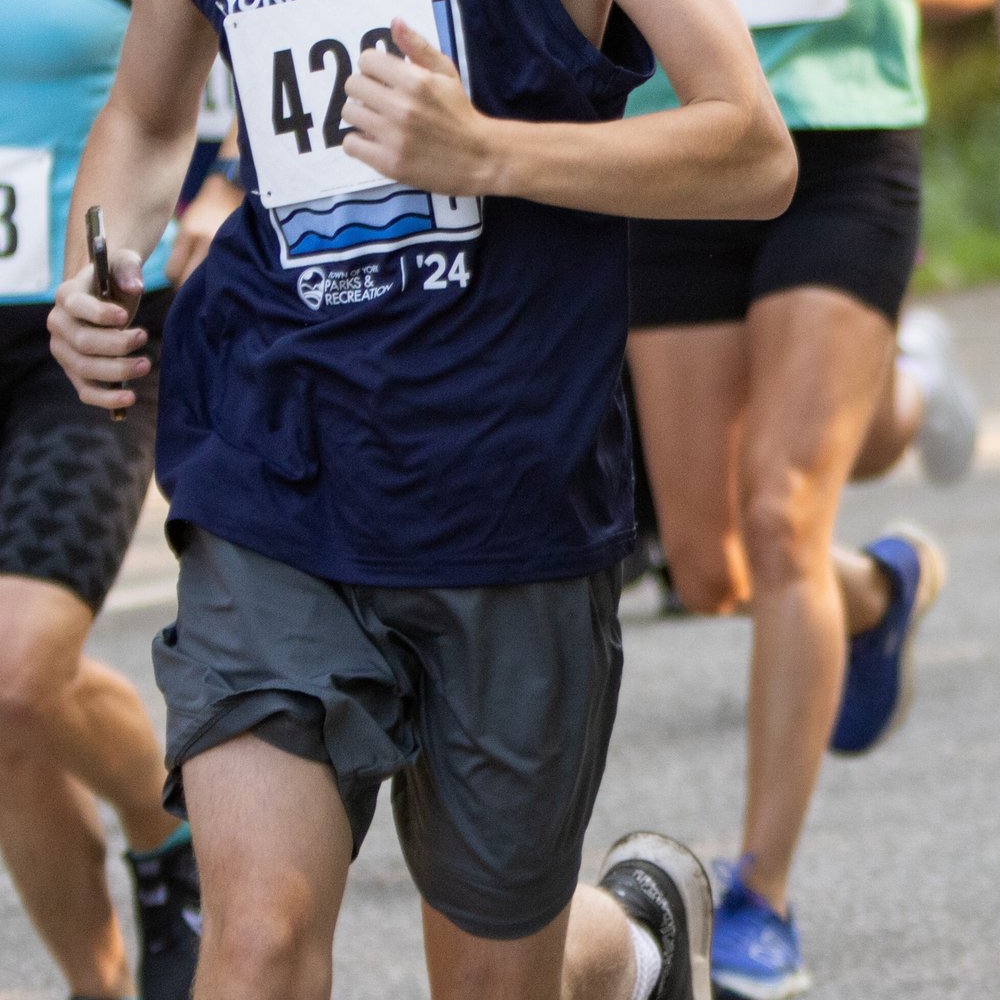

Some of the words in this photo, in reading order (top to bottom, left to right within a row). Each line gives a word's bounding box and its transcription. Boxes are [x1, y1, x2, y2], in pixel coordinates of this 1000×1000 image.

[325, 276, 362, 292] PARKS
[364, 274, 374, 289] &
[416, 252, 470, 290] '24
[325, 282, 394, 306] RECREATION
